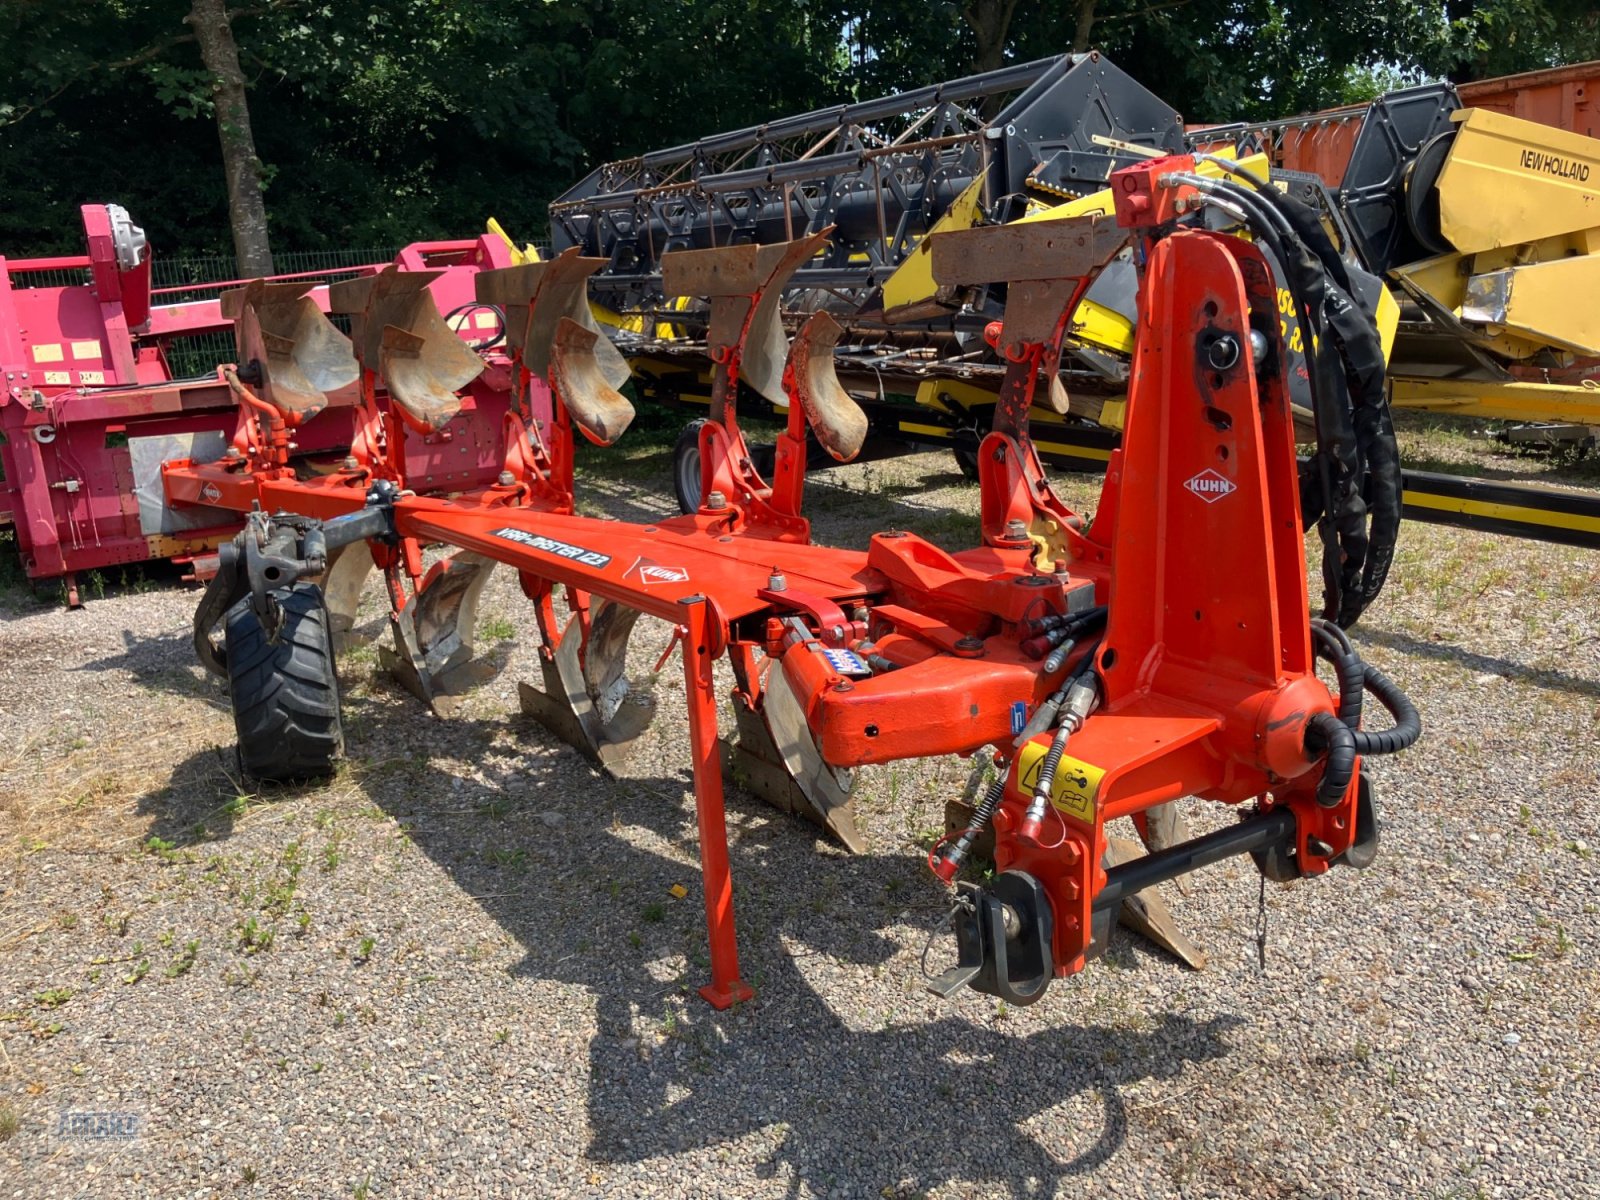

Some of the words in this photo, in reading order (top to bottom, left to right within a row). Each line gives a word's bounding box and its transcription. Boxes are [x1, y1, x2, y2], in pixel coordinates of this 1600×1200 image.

[1520, 150, 1544, 171] NEW
[1543, 155, 1590, 182] HOLLAND
[1191, 479, 1229, 492] KUHN
[496, 527, 584, 558] VARI-MASTER
[576, 552, 610, 566] 123
[643, 566, 686, 581] KUHN
